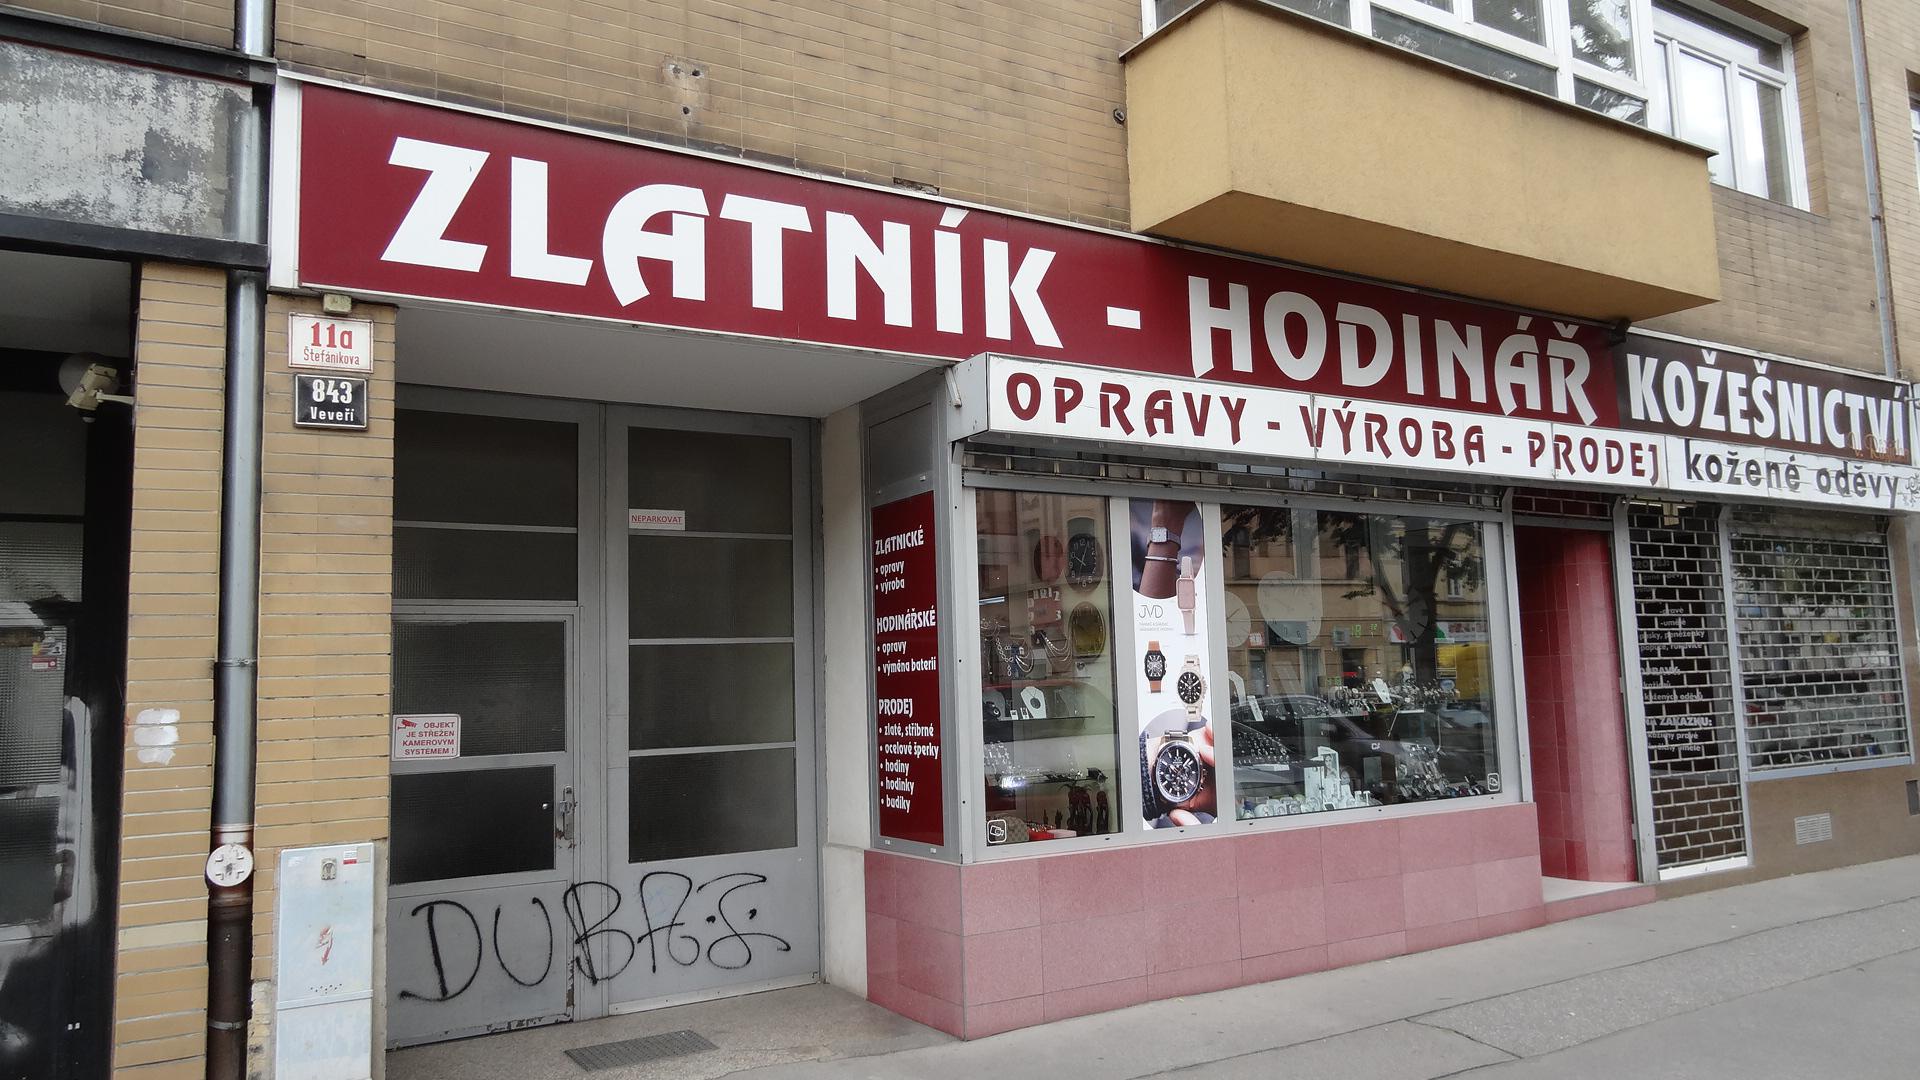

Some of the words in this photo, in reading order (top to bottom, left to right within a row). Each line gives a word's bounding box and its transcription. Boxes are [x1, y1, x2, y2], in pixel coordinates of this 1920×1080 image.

[380, 137, 1063, 349] ZLATNÍK
[1106, 306, 1141, 329] -
[1188, 275, 1599, 426] HODINÁŘ
[311, 322, 353, 350] 11a
[303, 346, 360, 366] Štefánikova
[312, 379, 353, 404] 843
[1626, 349, 1907, 457] KOŽEŠNICTVÍ
[310, 407, 354, 422] Veveří
[1006, 372, 1246, 446] OPRAVY
[1299, 401, 1486, 467] VÝROBA
[1528, 431, 1659, 487] PRODEJ
[1685, 439, 1801, 491] kožené
[1816, 460, 1898, 509] oděvy
[631, 514, 683, 523] NEPARKOVAT
[875, 525, 924, 556] ZLATNICKÉ
[880, 560, 905, 576] opravy
[880, 578, 905, 594] výroba
[876, 605, 936, 634] HODINÁŘSKÉ
[1138, 604, 1164, 619] JVD
[882, 640, 907, 656] opravy
[882, 659, 910, 677] výměna
[911, 656, 937, 671] baterií
[878, 698, 914, 718] PRODEJ
[884, 723, 904, 738] zlaté,
[905, 722, 934, 737] stříbrné
[884, 742, 913, 756] ocelové
[914, 742, 940, 760] šperky
[885, 759, 910, 776] hodiny
[886, 776, 915, 795] hodinky
[886, 797, 911, 814] budíky
